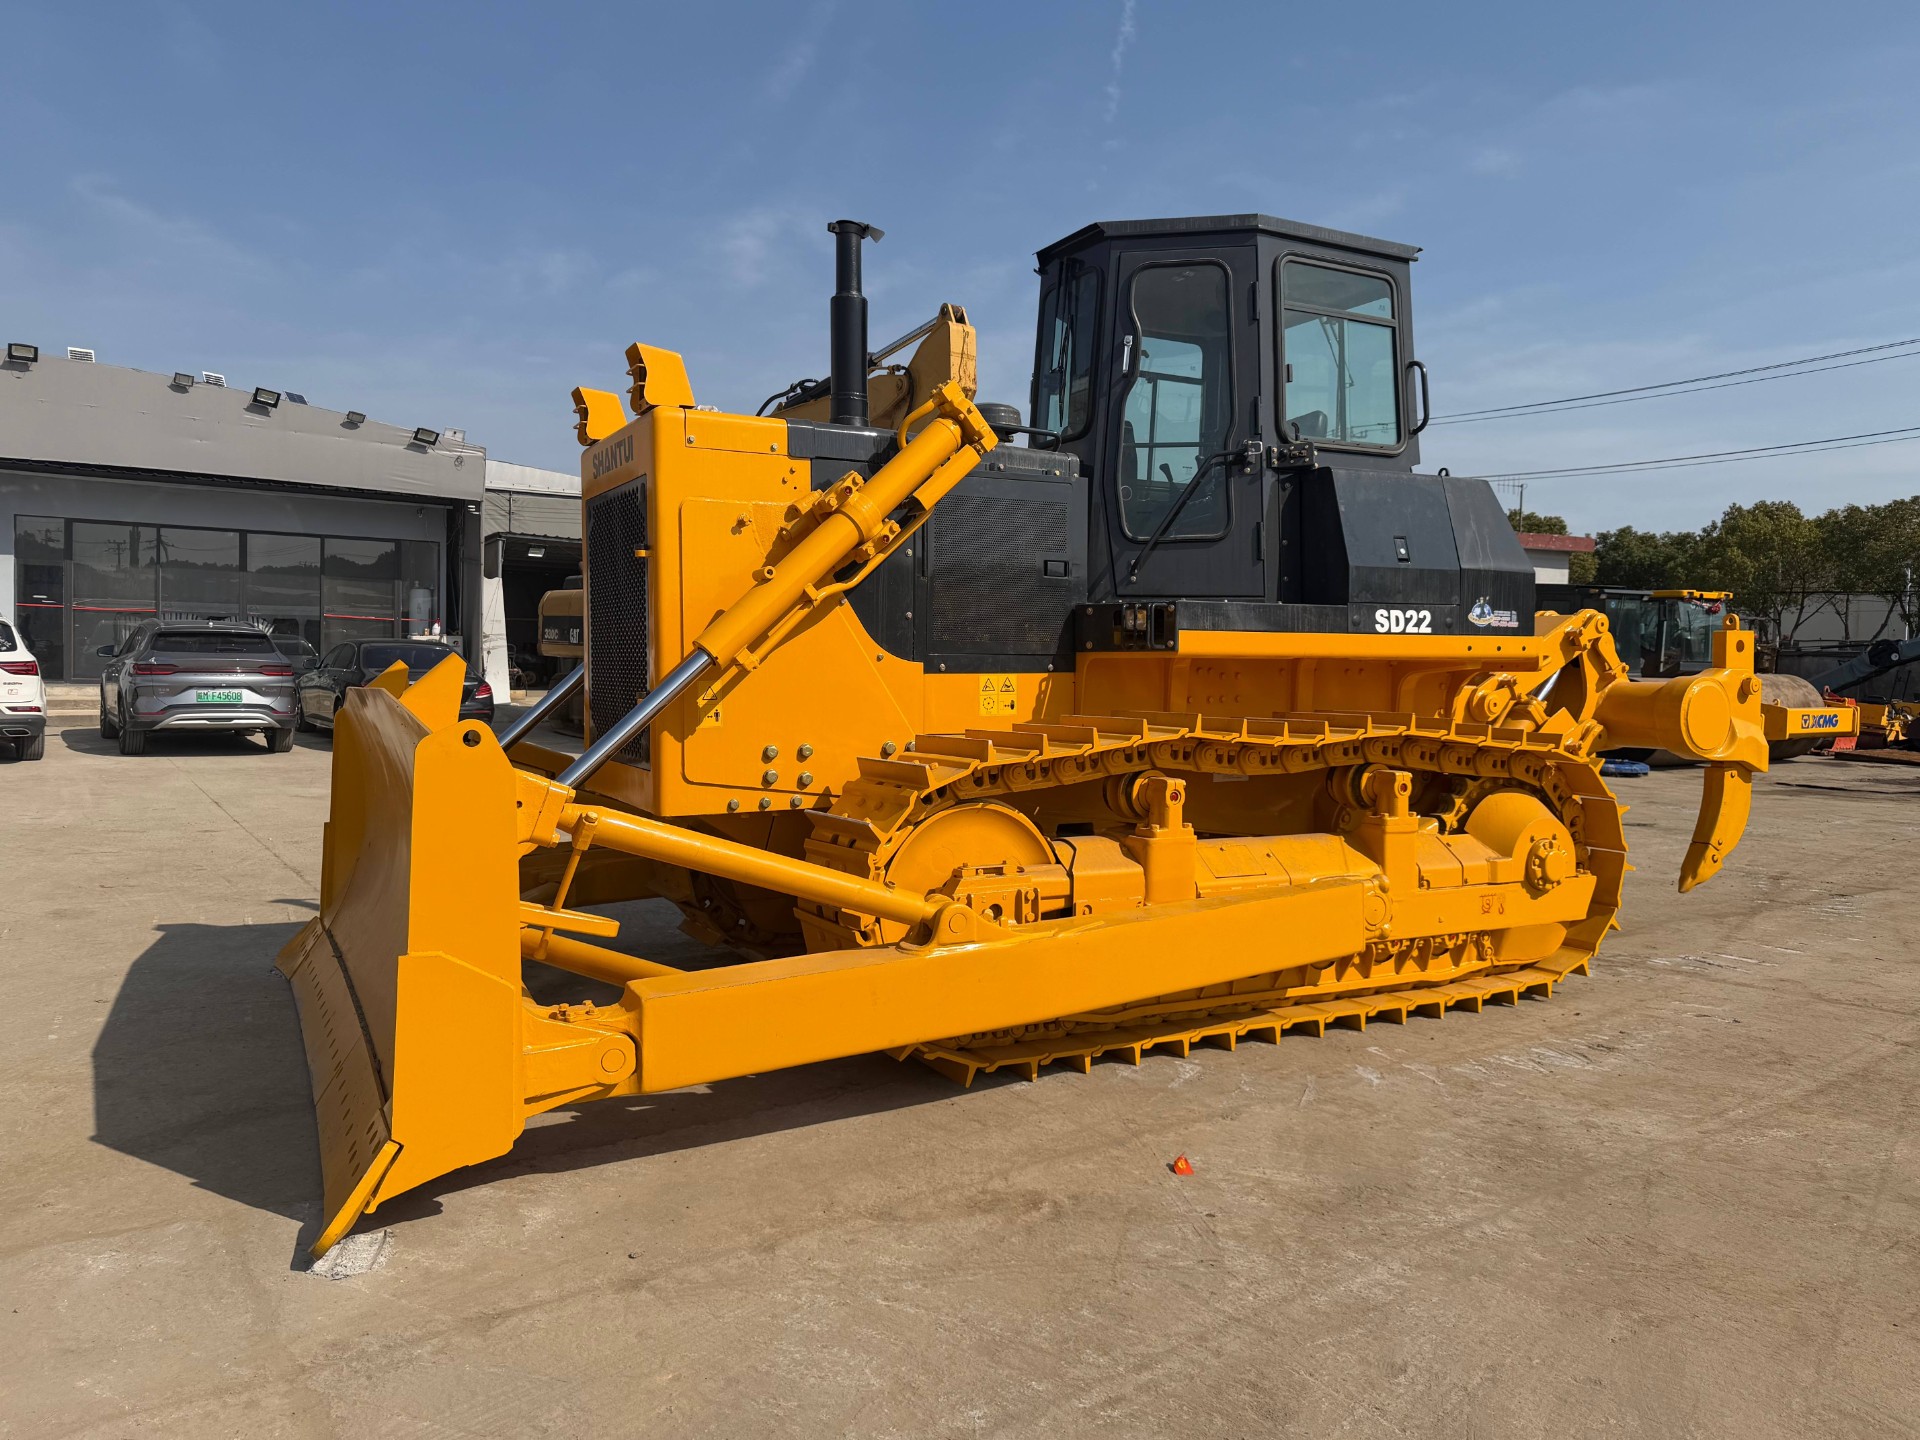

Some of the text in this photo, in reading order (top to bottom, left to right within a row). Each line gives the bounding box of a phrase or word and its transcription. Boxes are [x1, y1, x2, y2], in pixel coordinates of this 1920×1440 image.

[592, 434, 634, 480] SHANTUI
[1374, 608, 1432, 634] SD22
[1810, 713, 1839, 729] XCMG
